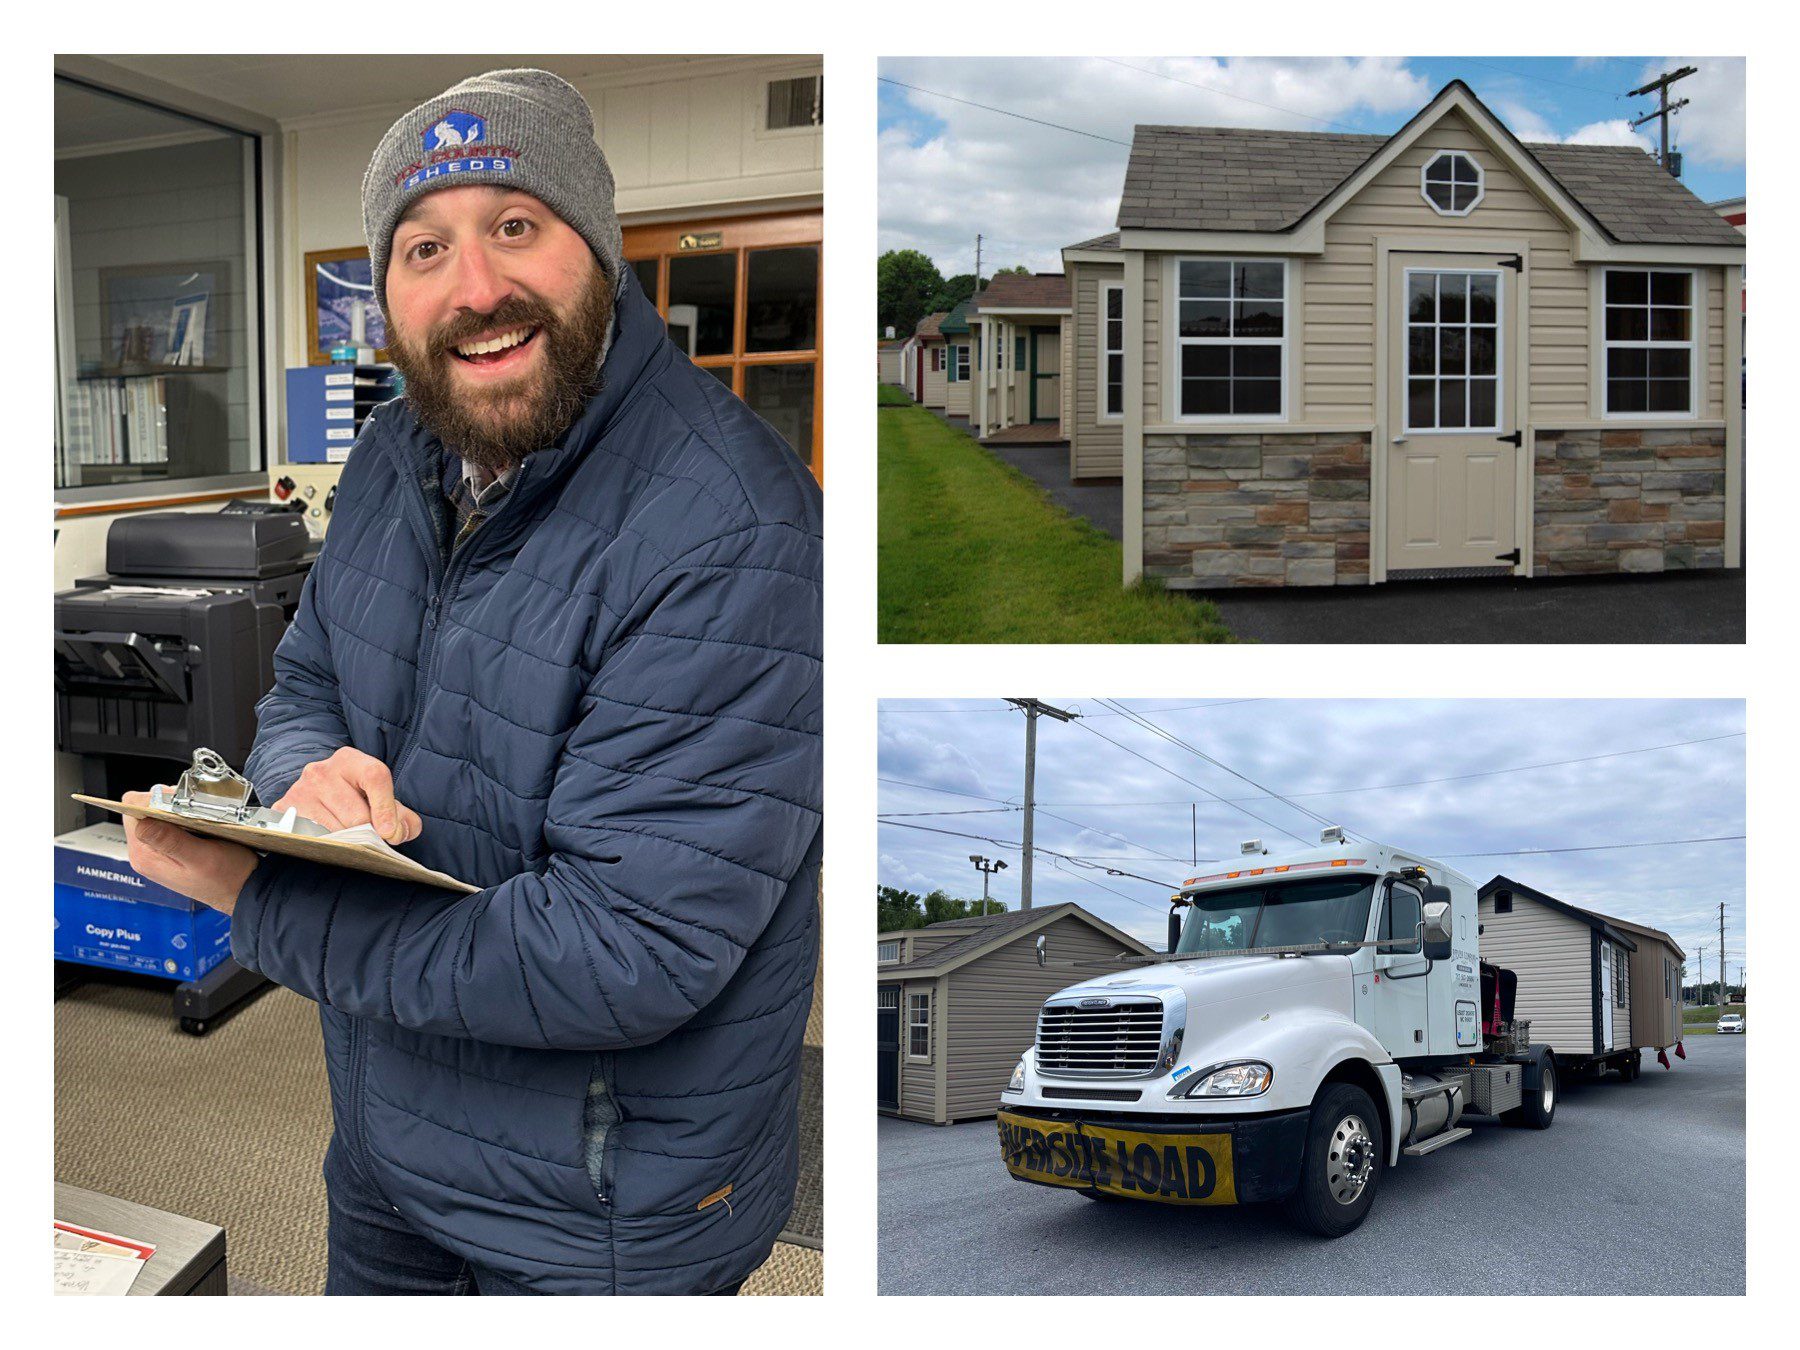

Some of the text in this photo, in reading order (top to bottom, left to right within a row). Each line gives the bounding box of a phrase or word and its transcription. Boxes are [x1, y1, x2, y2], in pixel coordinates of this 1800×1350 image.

[409, 160, 506, 187] SHEDS
[77, 865, 146, 888] HAMMERMILL
[86, 923, 142, 941] Copy Plus
[1117, 1140, 1217, 1199] LOAD
